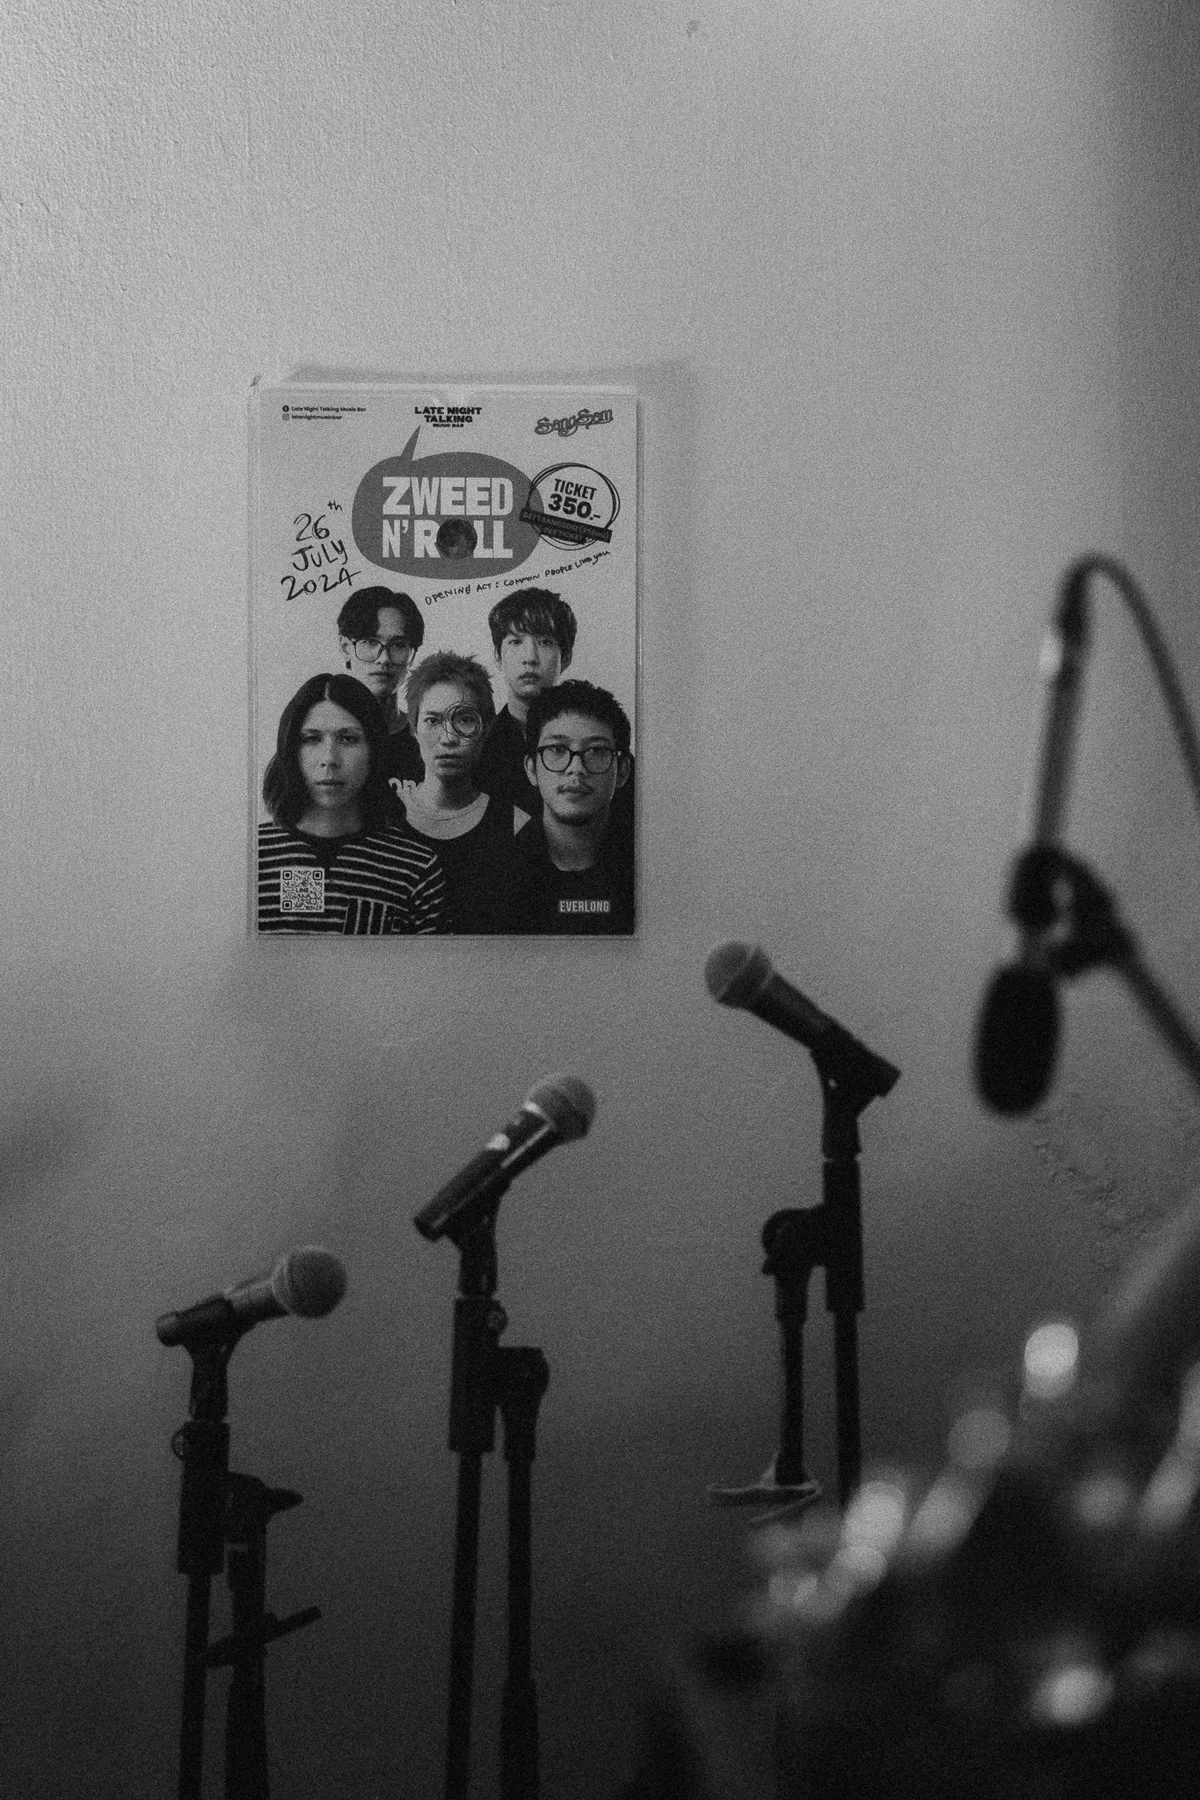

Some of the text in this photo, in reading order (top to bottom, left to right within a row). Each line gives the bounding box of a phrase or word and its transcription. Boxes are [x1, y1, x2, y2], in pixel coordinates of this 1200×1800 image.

[414, 406, 483, 415] LATE NIGHT
[424, 415, 473, 423] TALKING
[382, 476, 514, 516] ZWEED
[554, 478, 598, 500] TICKET
[291, 539, 348, 571] JULY
[280, 567, 361, 601] 2024
[425, 584, 471, 605] OPENING
[559, 900, 611, 912] EVERLONG
